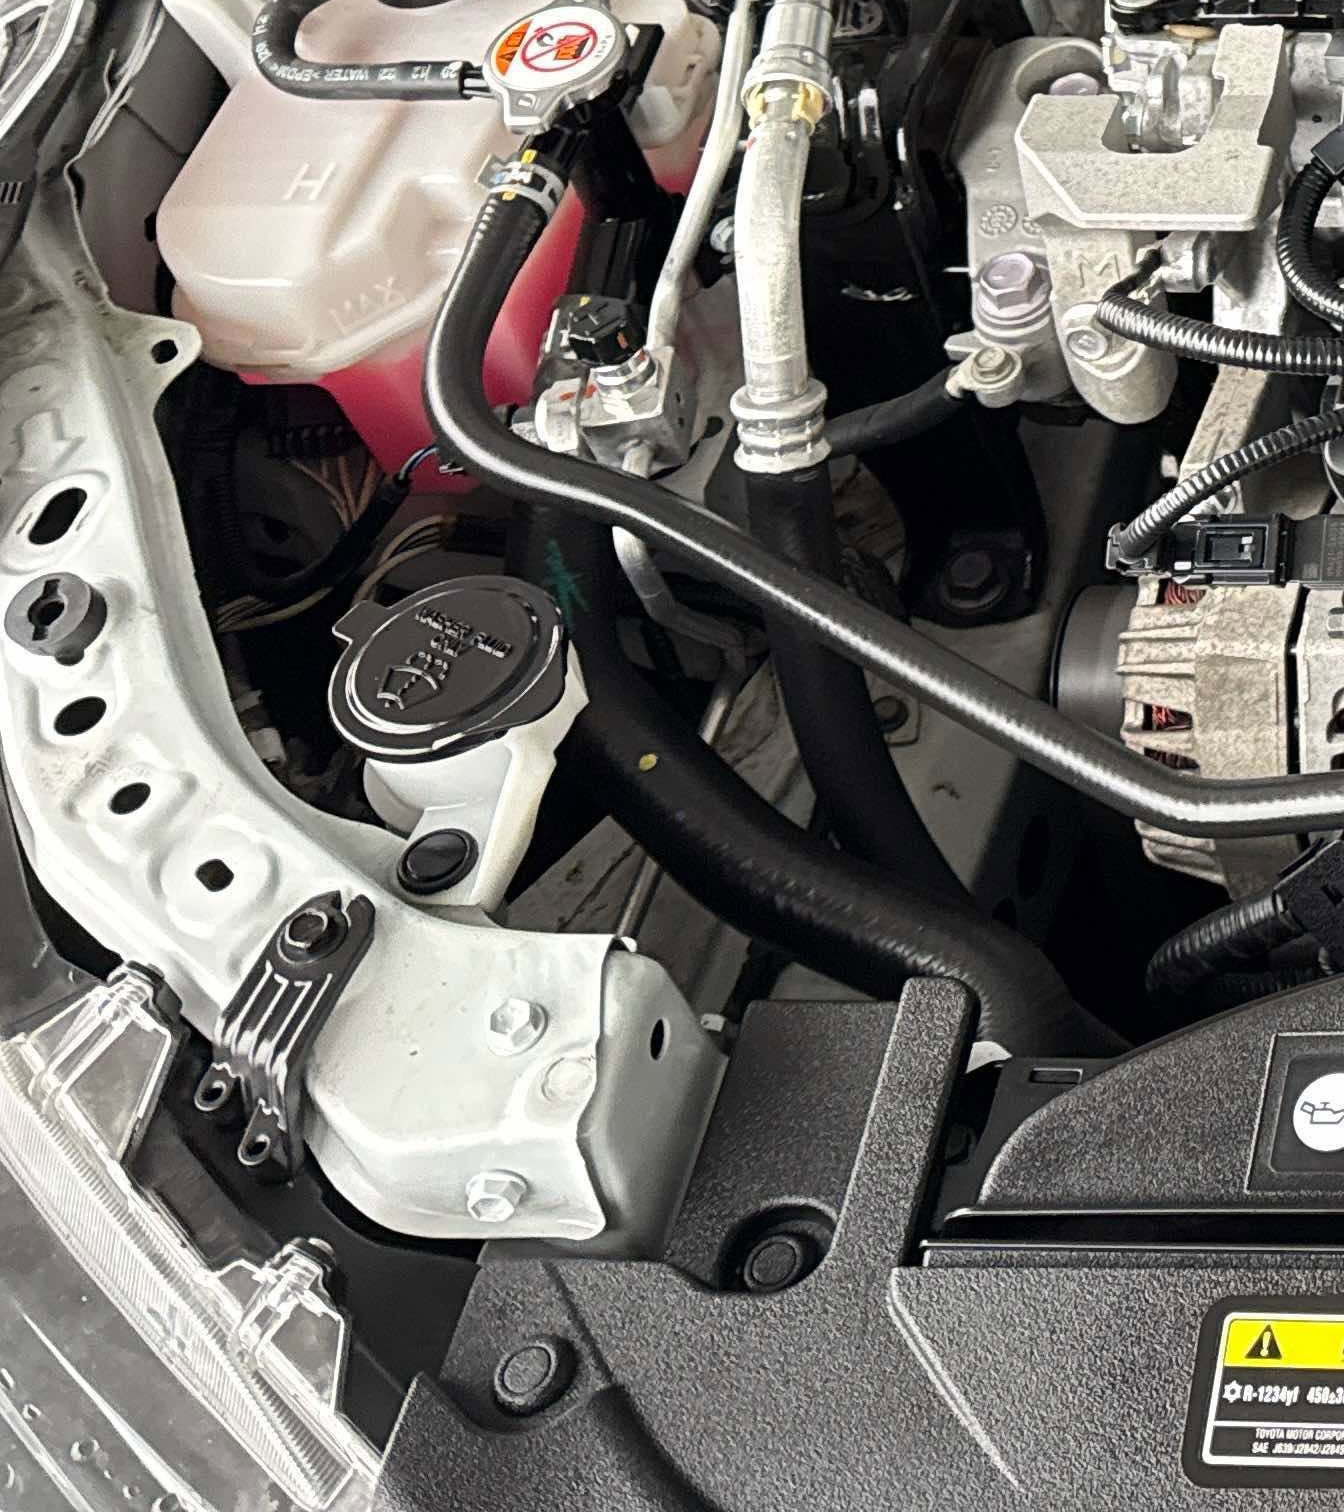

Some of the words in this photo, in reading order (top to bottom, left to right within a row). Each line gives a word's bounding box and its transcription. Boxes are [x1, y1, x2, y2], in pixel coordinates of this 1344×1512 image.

[324, 67, 369, 82] WATER
[281, 161, 337, 201] H
[1242, 1384, 1300, 1406] R-1234yf
[1255, 1428, 1284, 1440] TOYOTA
[1286, 1429, 1314, 1441] MOTOR
[1252, 1441, 1270, 1454] SAE
